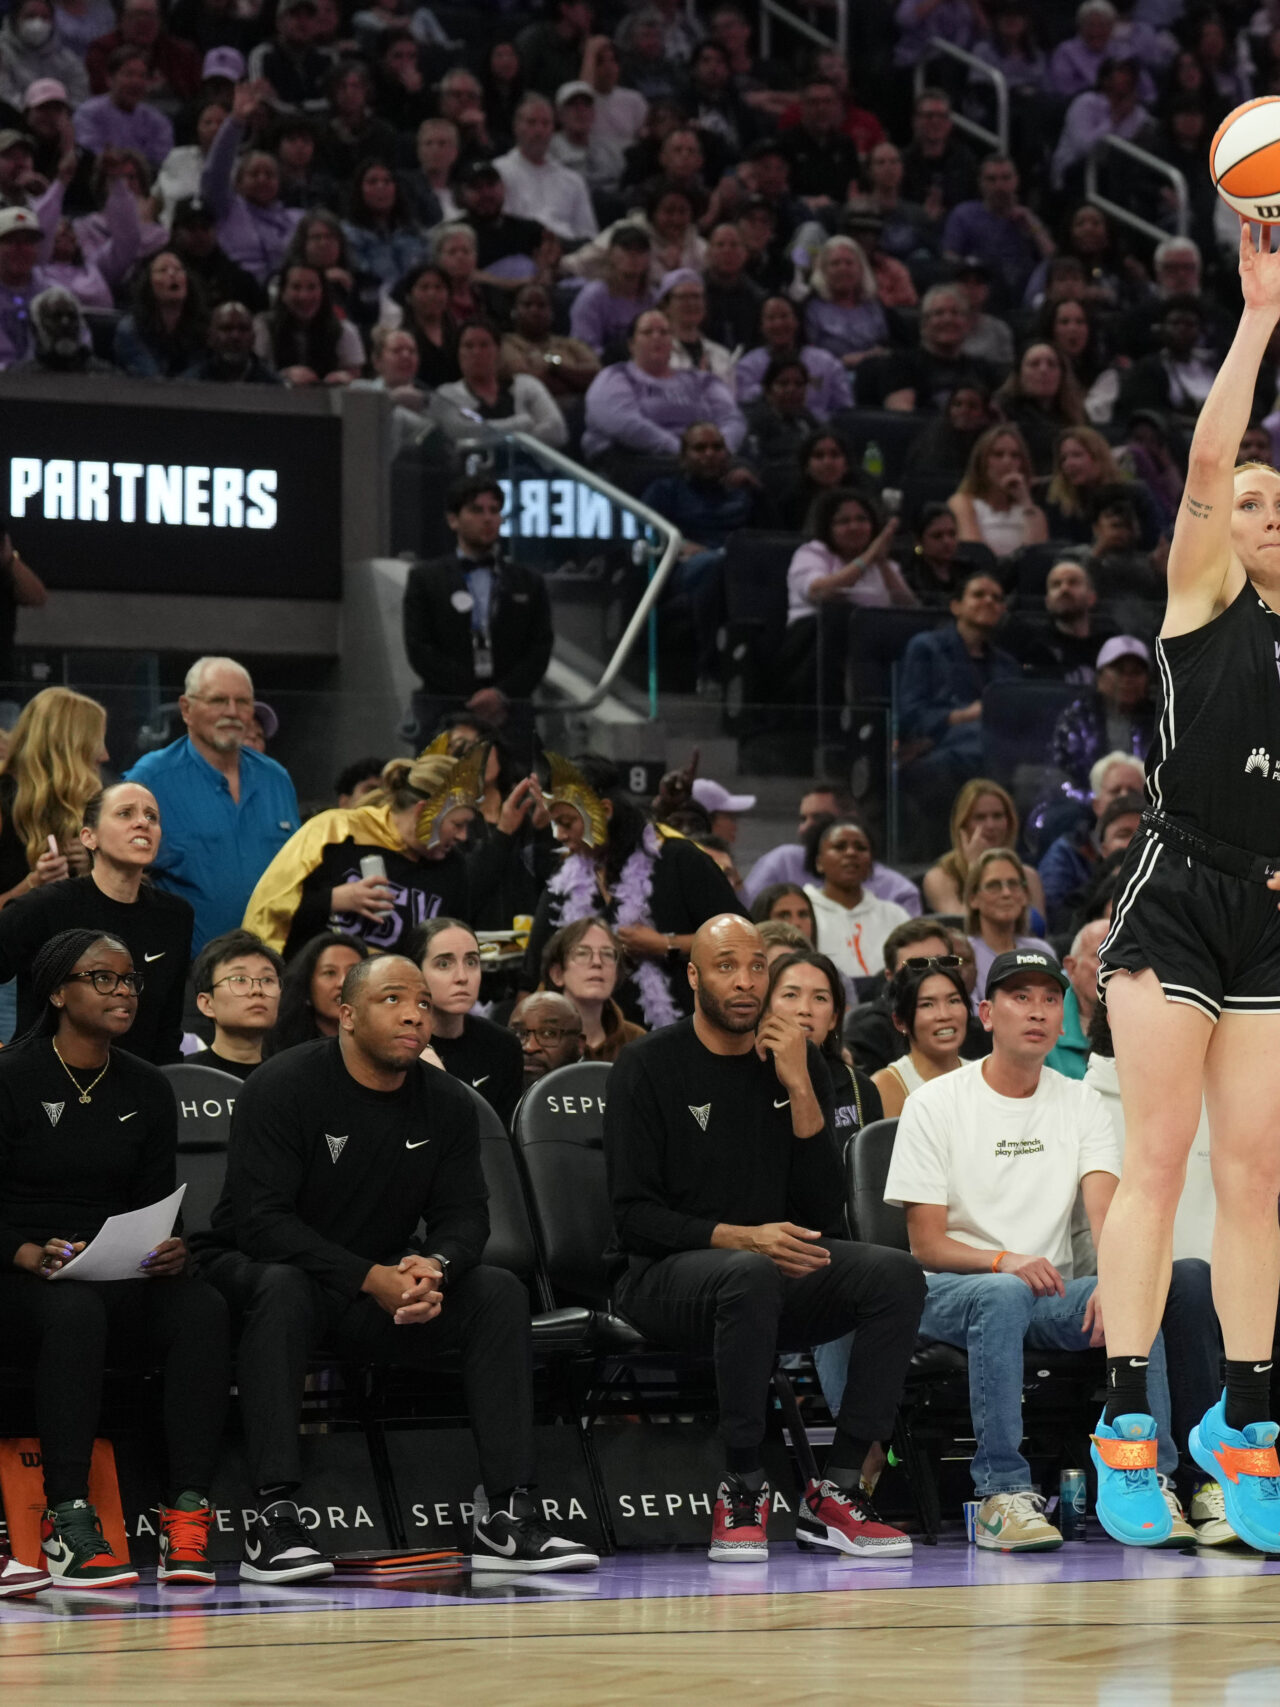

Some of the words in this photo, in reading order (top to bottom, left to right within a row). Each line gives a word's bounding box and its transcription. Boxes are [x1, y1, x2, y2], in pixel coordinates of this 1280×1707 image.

[10, 457, 278, 530] PARTNERS
[629, 766, 647, 792] 8
[995, 1147, 1011, 1158] play
[996, 1140, 1006, 1148] all
